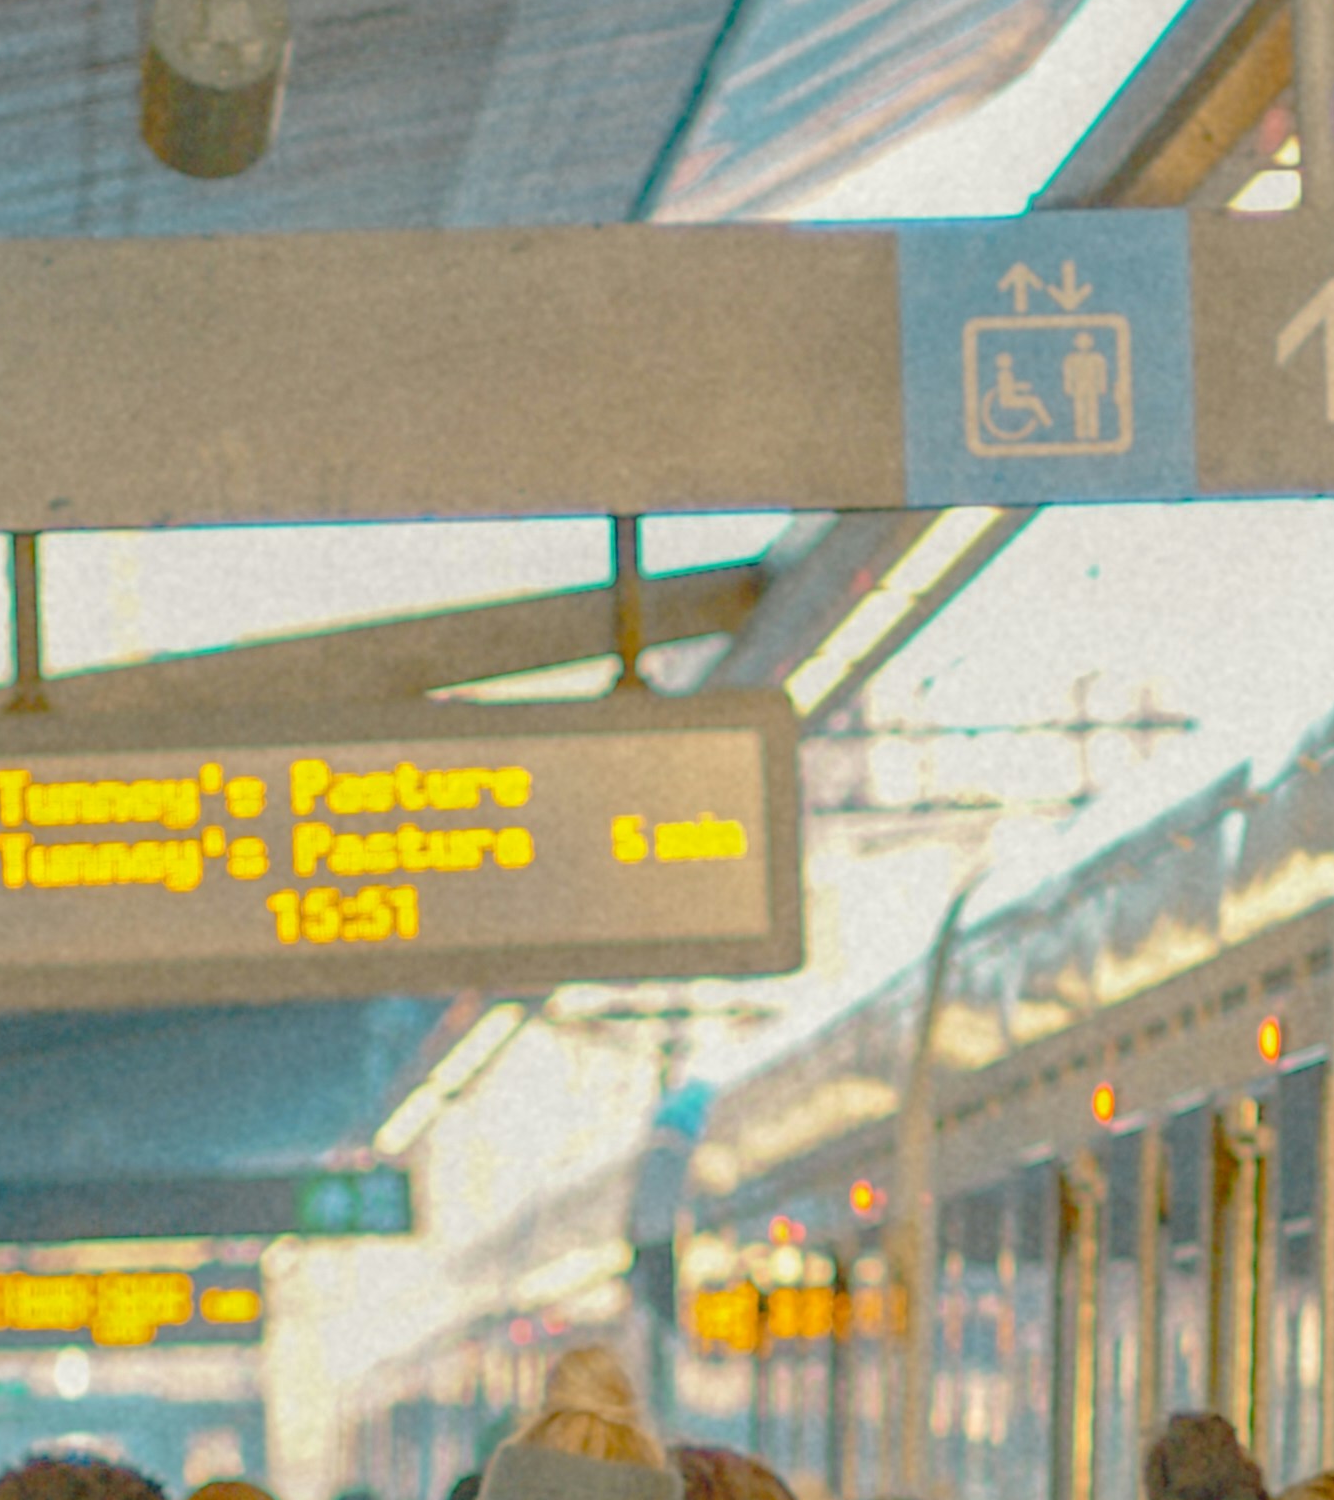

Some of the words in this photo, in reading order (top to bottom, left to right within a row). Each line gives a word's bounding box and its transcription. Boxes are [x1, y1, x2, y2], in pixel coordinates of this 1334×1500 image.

[290, 758, 532, 816] Pasture
[293, 822, 535, 878] Pasture
[612, 814, 648, 863] 5
[654, 812, 748, 862] min
[267, 884, 419, 944] 15:51
